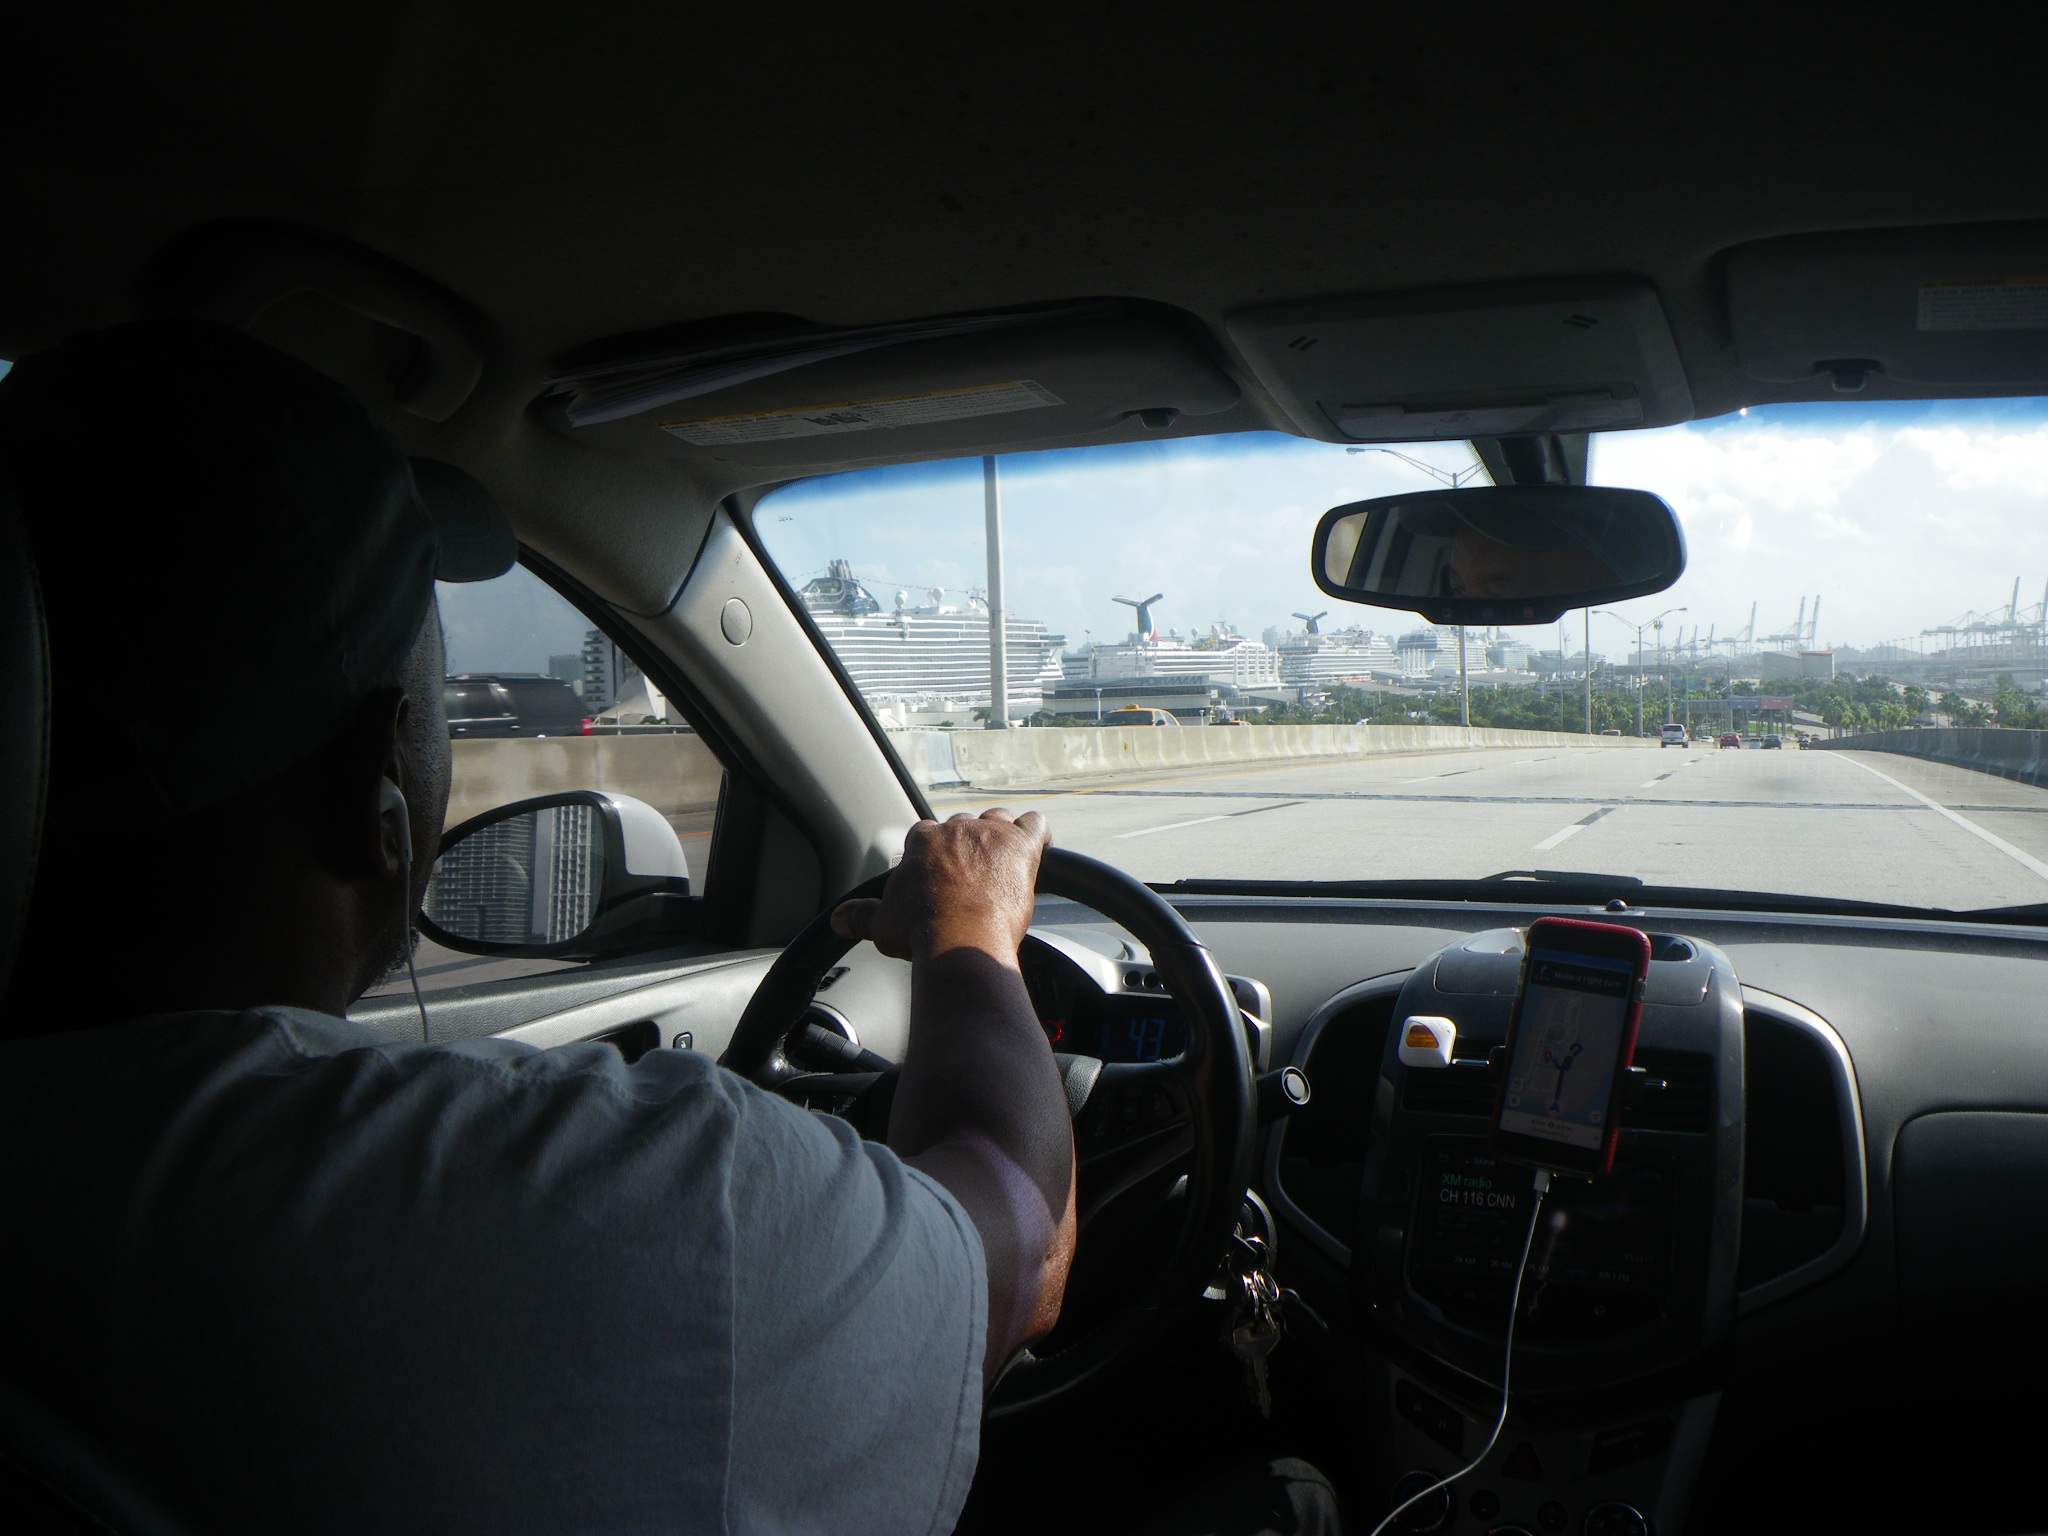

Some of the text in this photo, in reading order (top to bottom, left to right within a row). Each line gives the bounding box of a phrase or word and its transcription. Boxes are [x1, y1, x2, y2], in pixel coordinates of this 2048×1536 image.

[1129, 1018, 1165, 1061] 43
[1442, 1173, 1492, 1190] XM radio
[1440, 1188, 1516, 1209] CH 116 CNN
